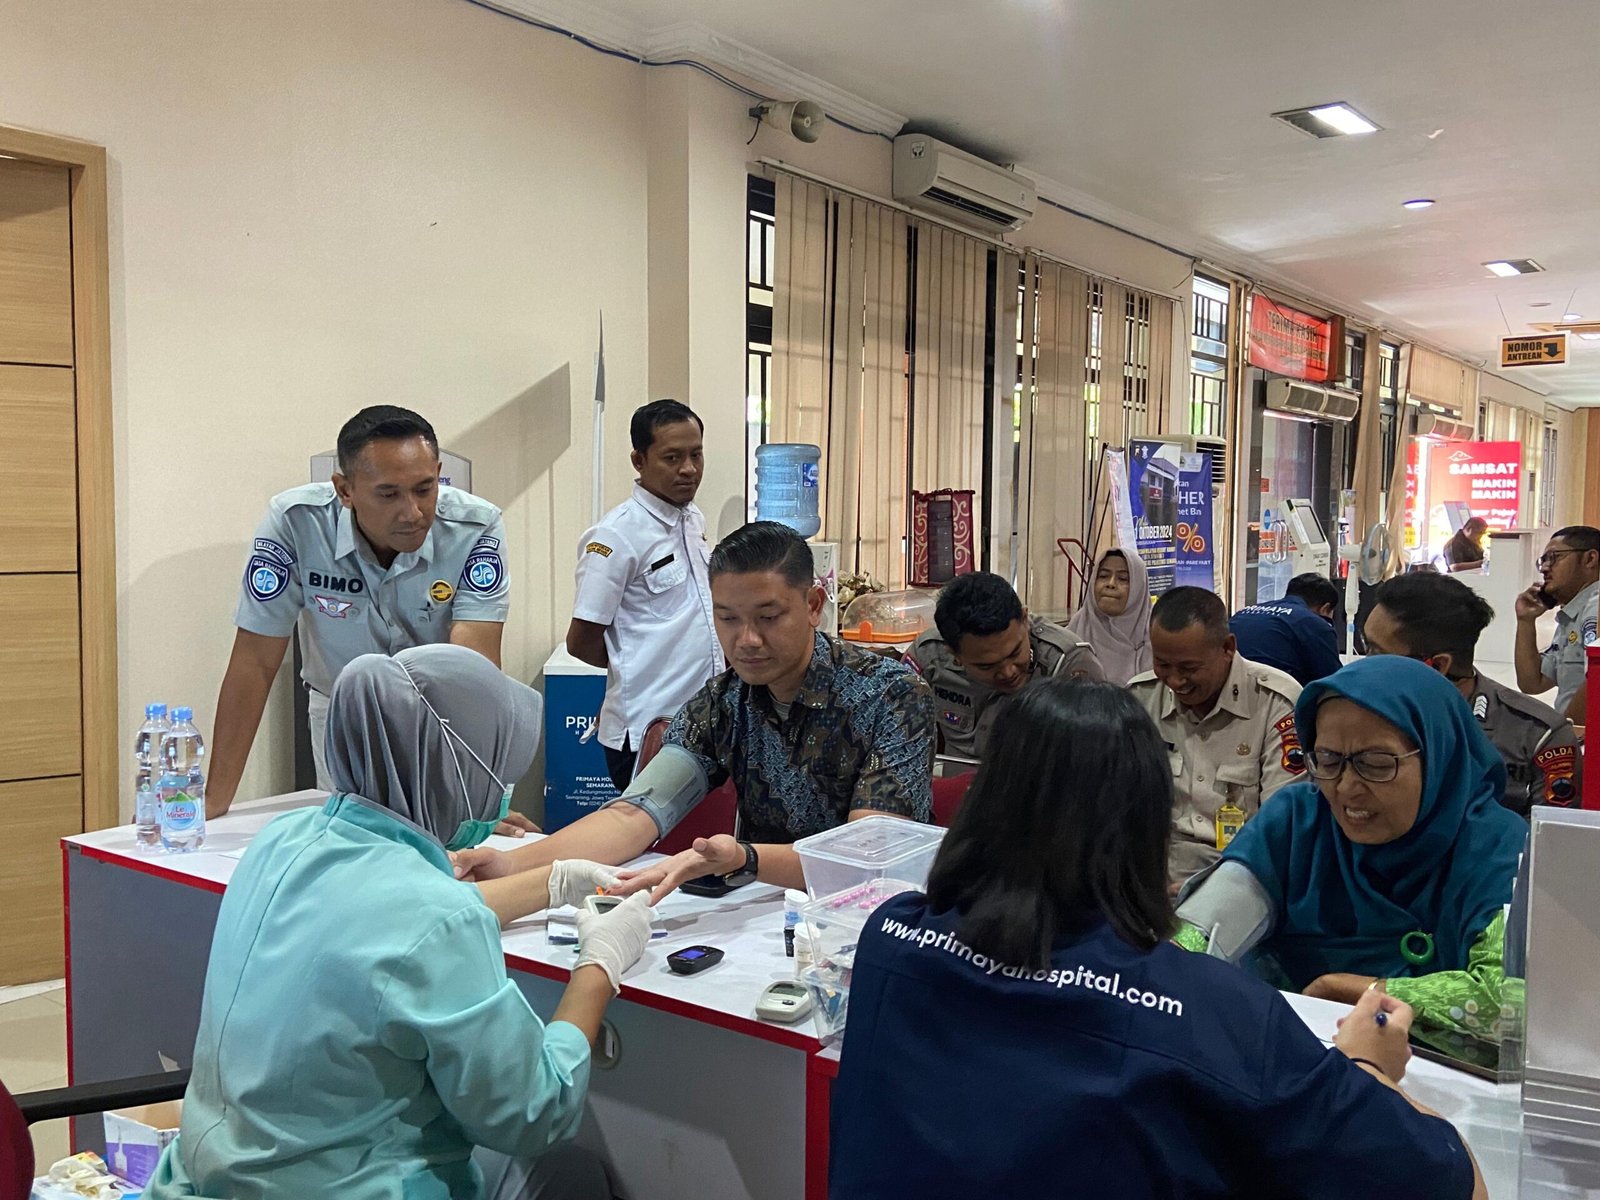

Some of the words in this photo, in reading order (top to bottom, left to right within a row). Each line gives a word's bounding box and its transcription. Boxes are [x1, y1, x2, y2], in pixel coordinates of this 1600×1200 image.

[1268, 309, 1294, 337] TERIMA
[1507, 341, 1542, 352] NOMOR
[1507, 352, 1542, 361] ANTREAN
[1448, 463, 1518, 475] SAMSAT
[1471, 479, 1517, 489] MAKIN
[1178, 491, 1205, 505] HER
[1471, 489, 1517, 500] MAKIN
[1139, 526, 1160, 540] OKTOBER
[1160, 525, 1173, 539] 2024
[308, 571, 364, 594] BIMO
[565, 716, 597, 729] PRI
[1537, 747, 1574, 763] POLDA
